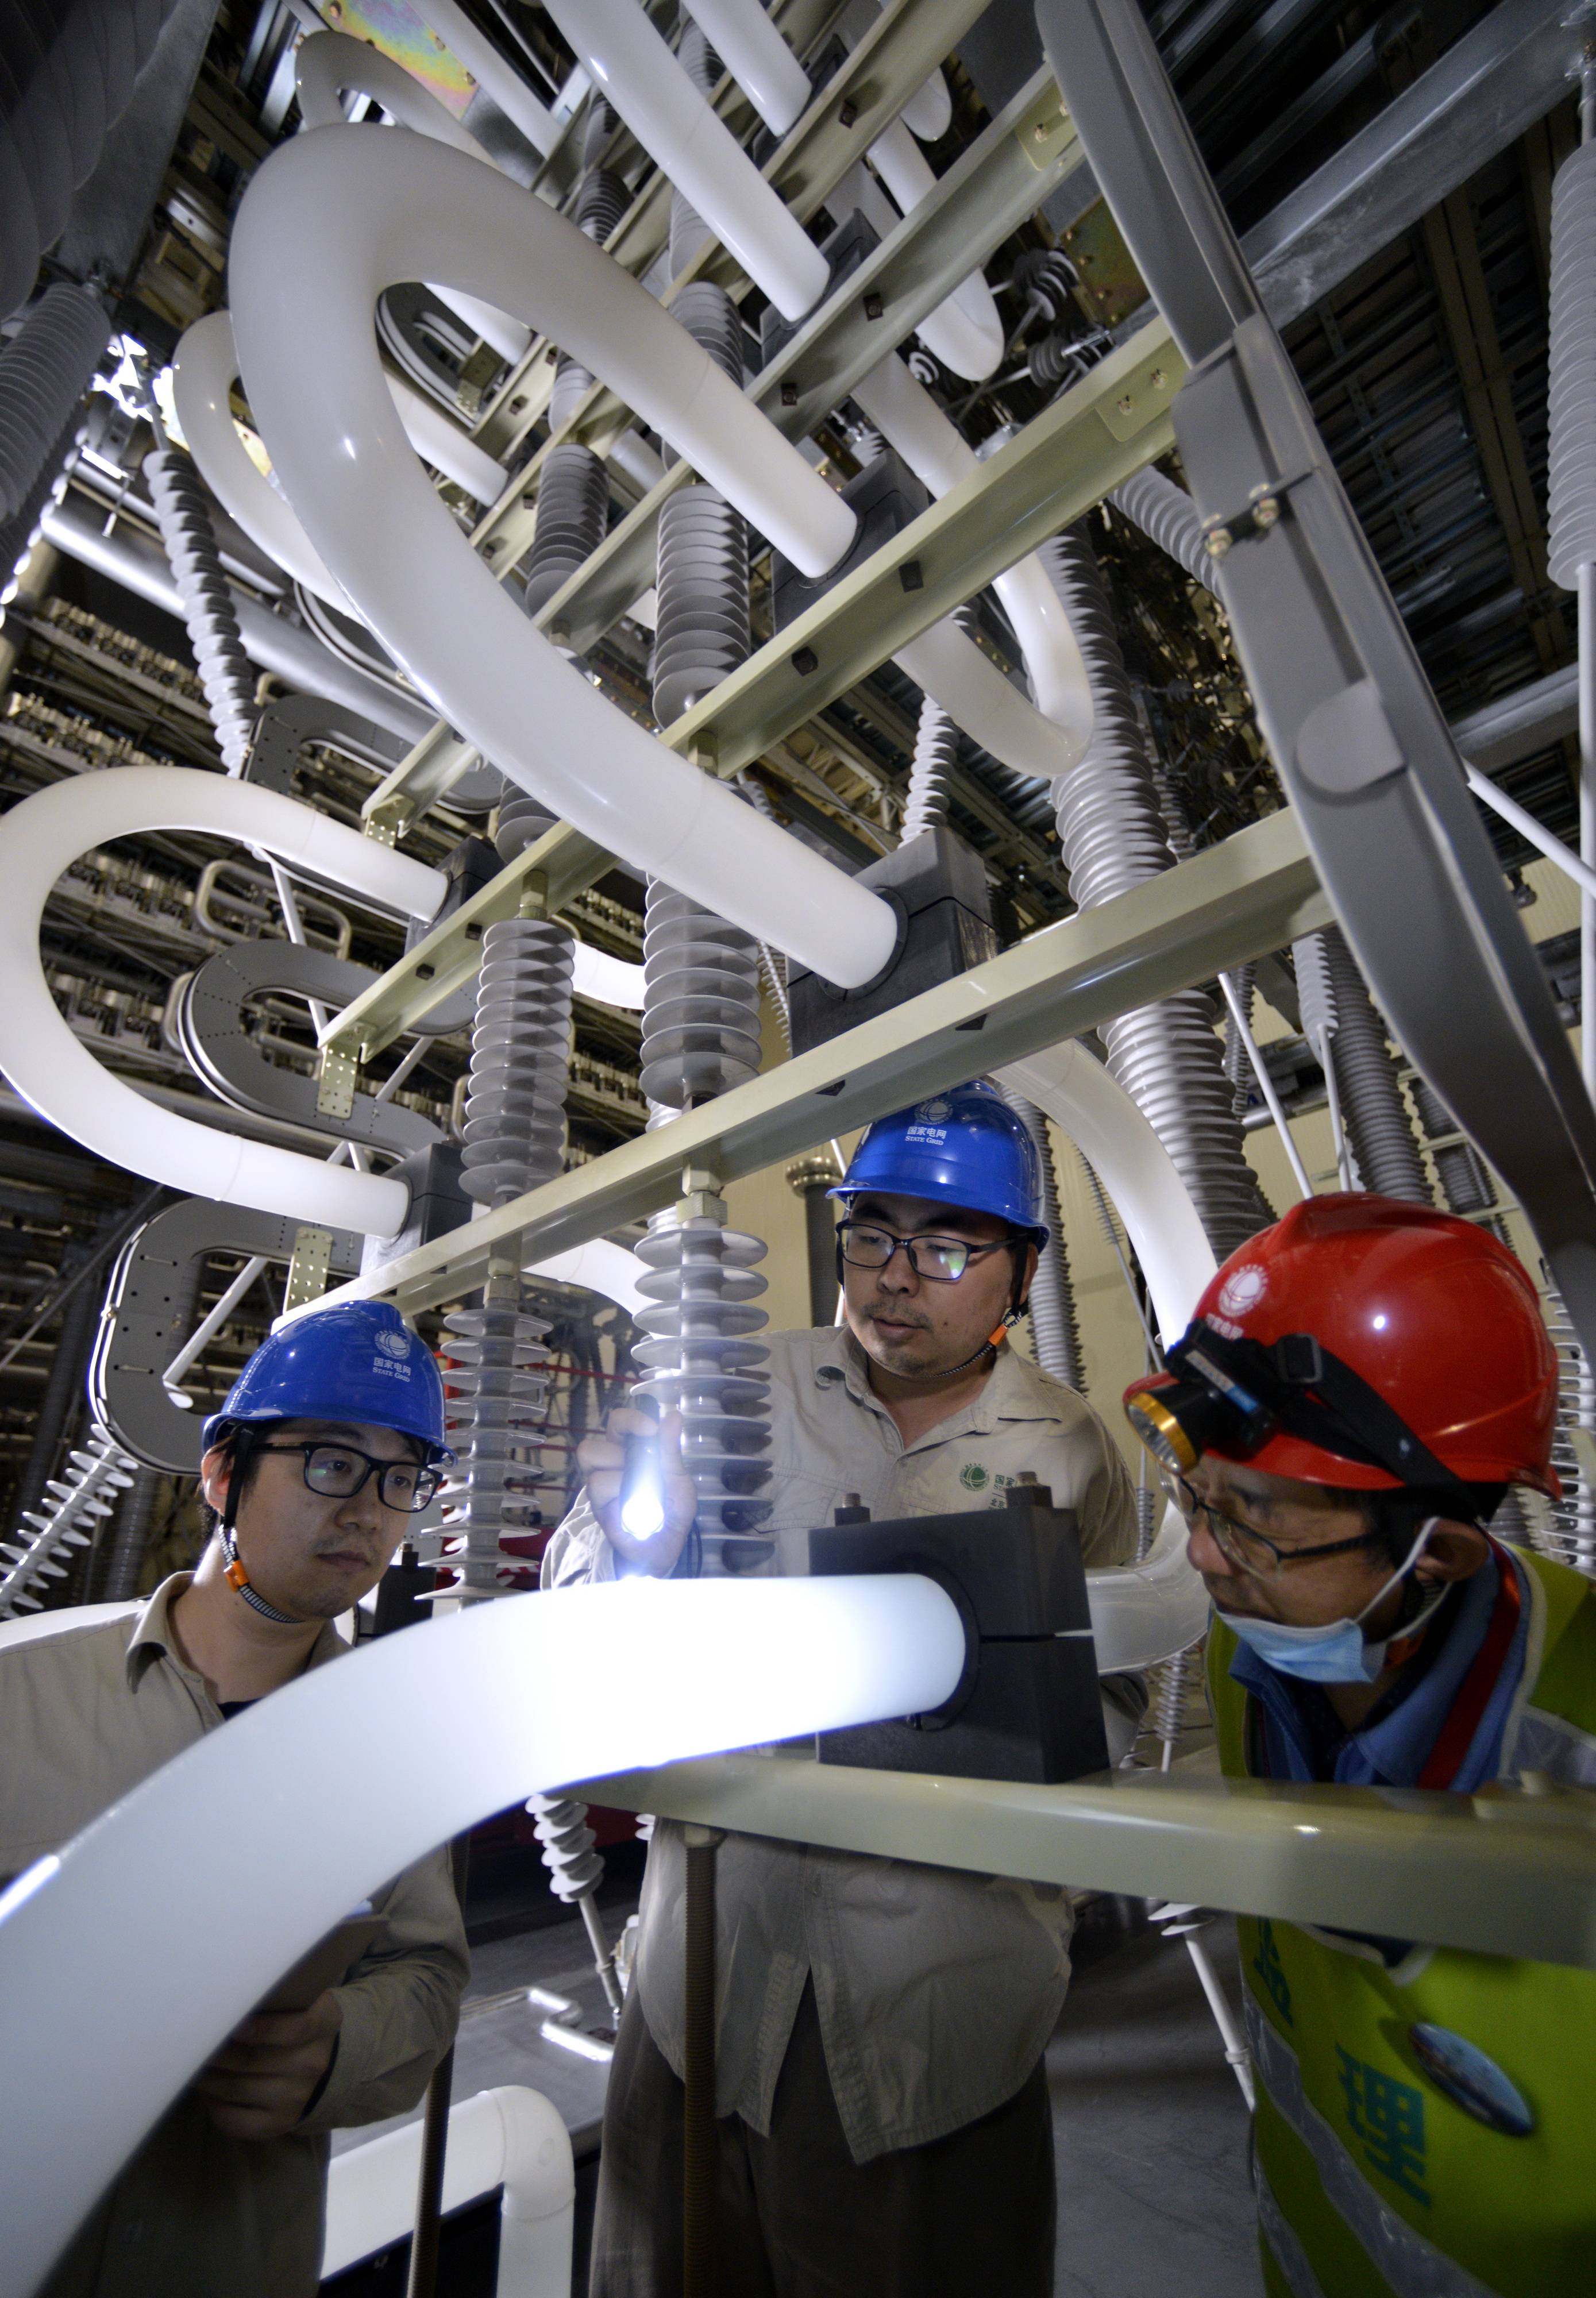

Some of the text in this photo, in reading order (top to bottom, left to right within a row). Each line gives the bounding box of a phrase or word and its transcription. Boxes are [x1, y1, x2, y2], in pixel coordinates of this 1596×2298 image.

[907, 1126, 947, 1139] 国家电网
[926, 1137, 944, 1146] GRID
[372, 1367, 394, 1377] STATE
[373, 1357, 411, 1376] 国家电网
